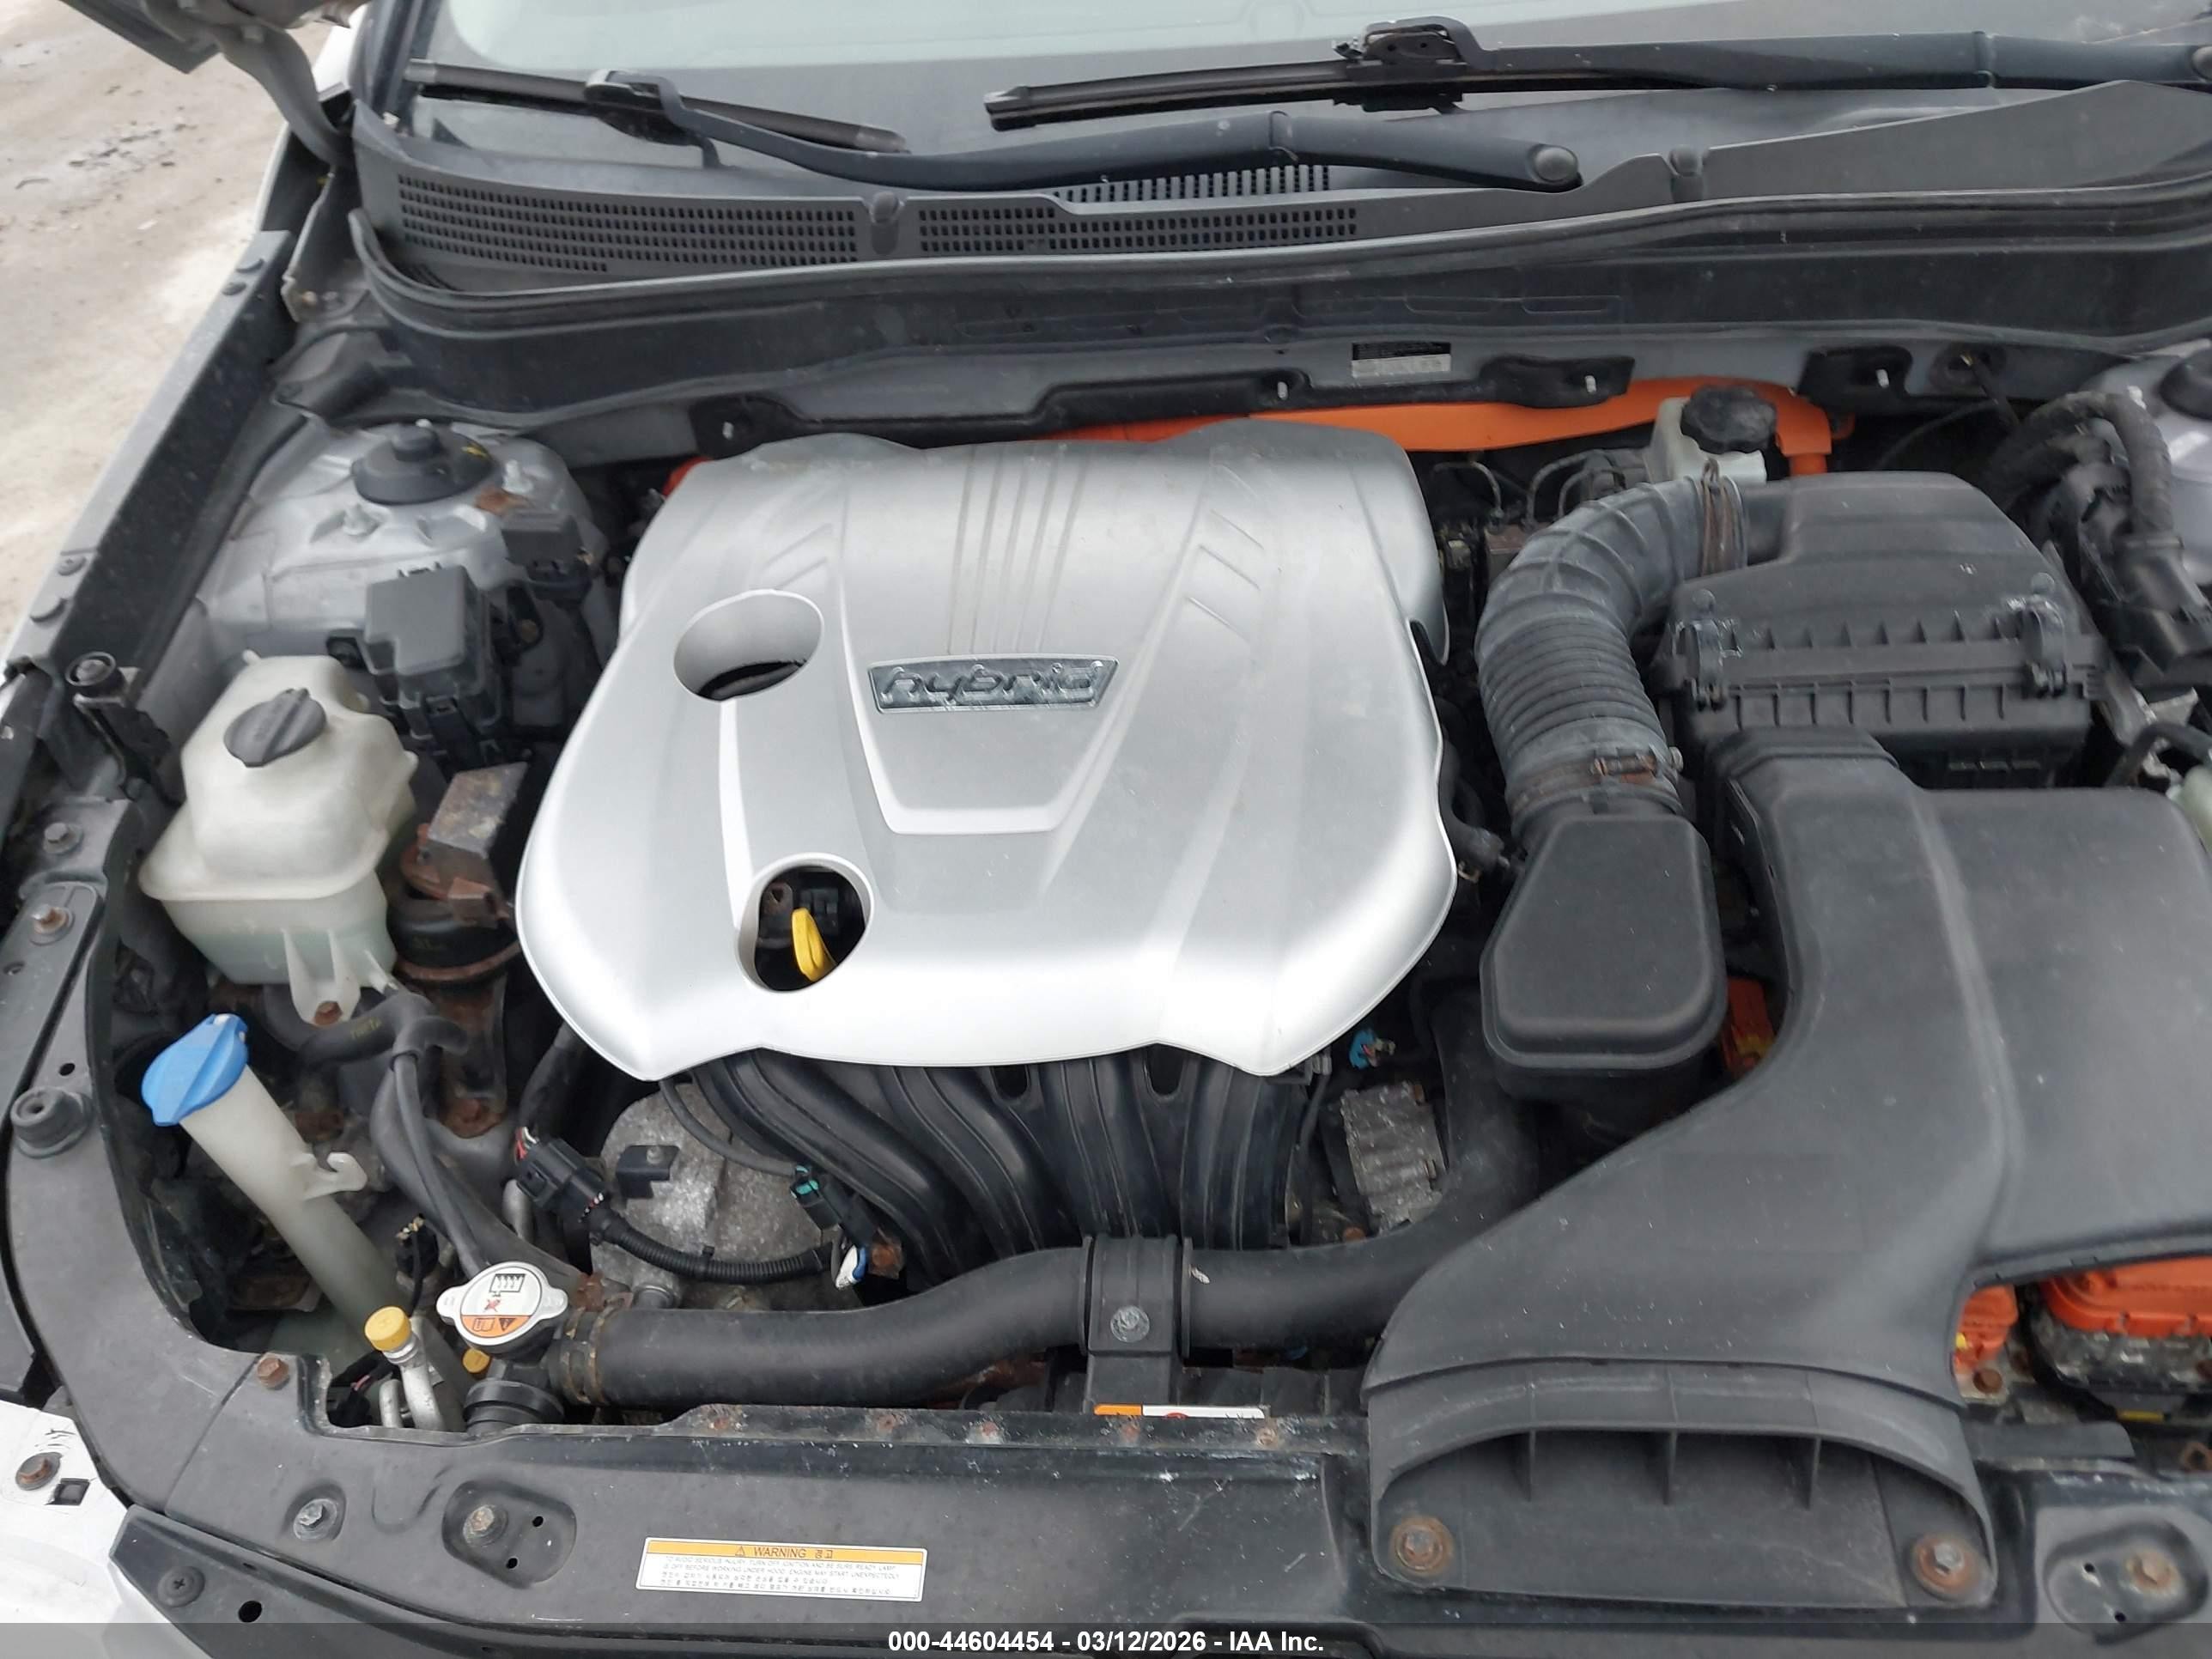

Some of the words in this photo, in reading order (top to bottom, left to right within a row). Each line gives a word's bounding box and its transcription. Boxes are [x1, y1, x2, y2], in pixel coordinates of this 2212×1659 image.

[880, 663, 1104, 705] hybrid
[754, 1547, 806, 1559] WARNING
[814, 1549, 833, 1559] 경고
